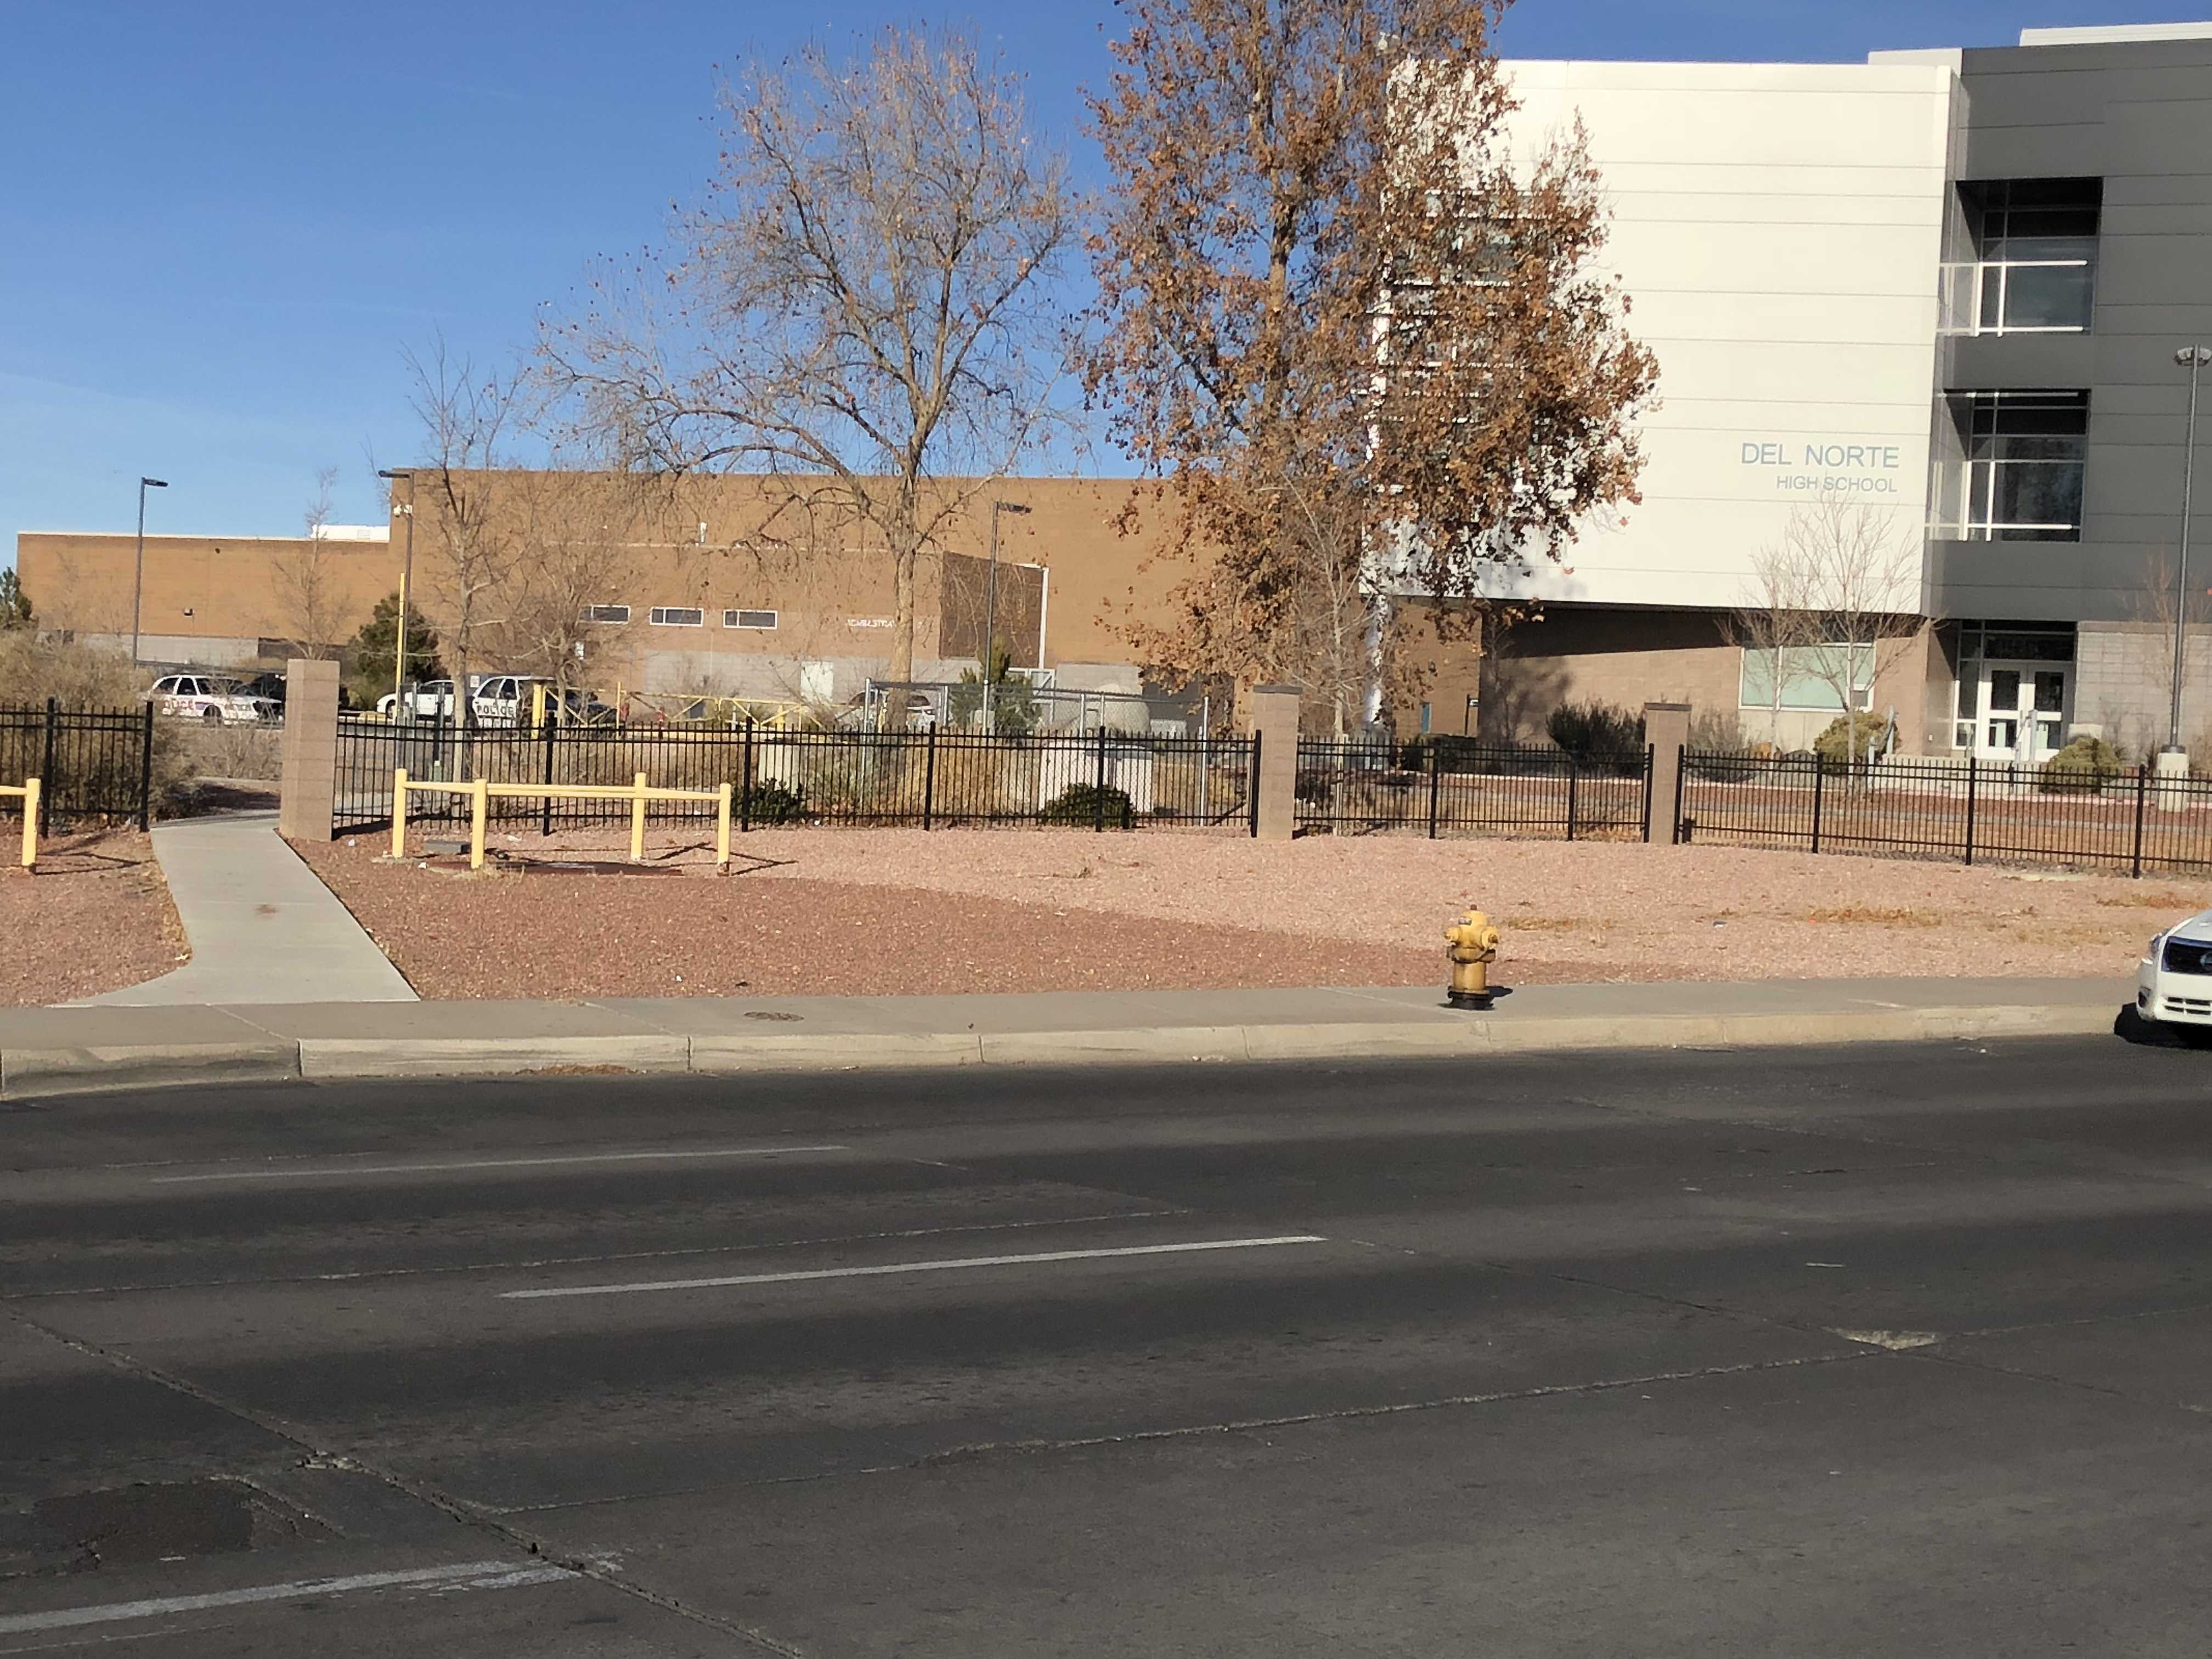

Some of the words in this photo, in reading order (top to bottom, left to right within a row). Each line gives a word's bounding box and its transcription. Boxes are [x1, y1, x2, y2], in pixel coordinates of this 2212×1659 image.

[1741, 442, 1792, 465] DEL
[1805, 444, 1899, 468] NORTE
[1777, 475, 1818, 490] HIGH
[1823, 476, 1898, 493] SCHOOL
